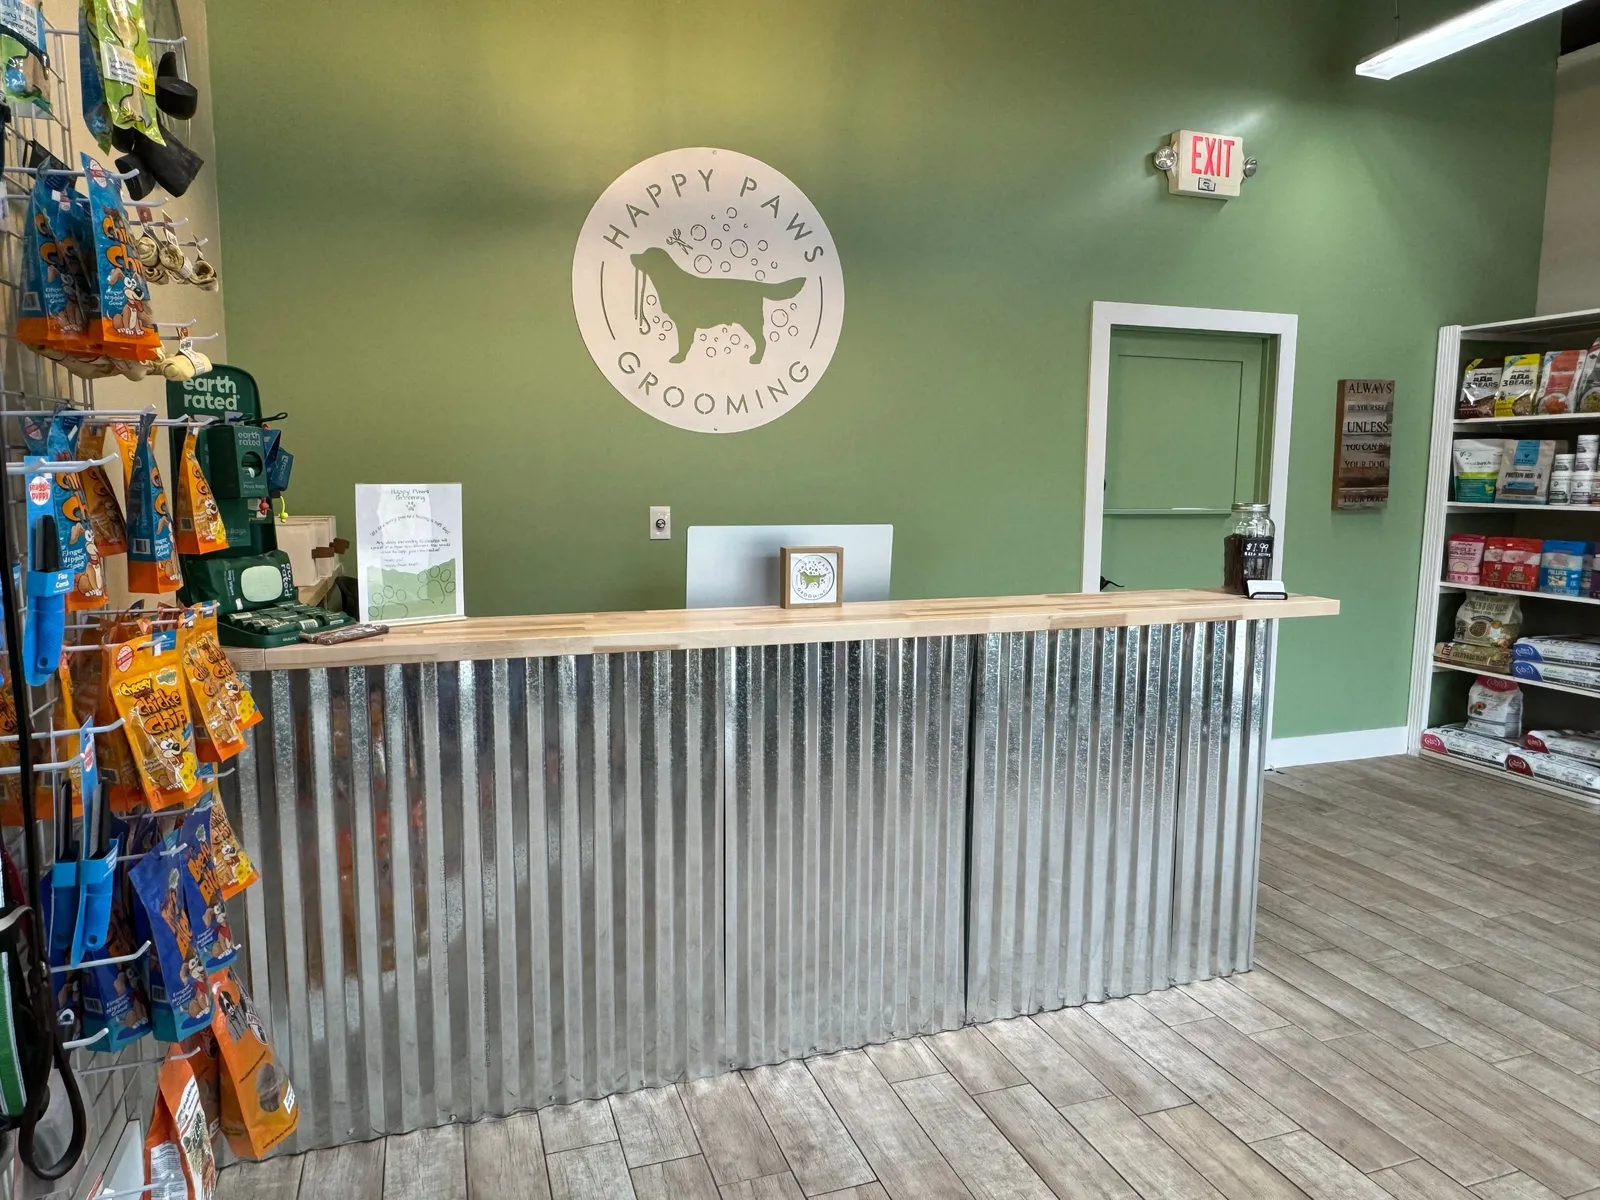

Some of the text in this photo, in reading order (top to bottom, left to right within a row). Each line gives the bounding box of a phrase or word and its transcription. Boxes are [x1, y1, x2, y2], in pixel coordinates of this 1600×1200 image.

[1191, 135, 1235, 178] EXIT
[603, 168, 824, 263] HAPPY PAWS
[182, 375, 237, 394] earth
[617, 351, 810, 415] GROOMING
[1348, 382, 1393, 394] ALWAYS
[1508, 378, 1534, 387] BEARS
[184, 393, 238, 411] rated
[1347, 421, 1389, 433] UNLESS
[238, 431, 260, 439] earth
[239, 439, 261, 447] rated
[1345, 443, 1361, 452] YOU
[1361, 443, 1377, 452] CAN
[1345, 460, 1366, 468] YOUR
[281, 563, 291, 598] rated
